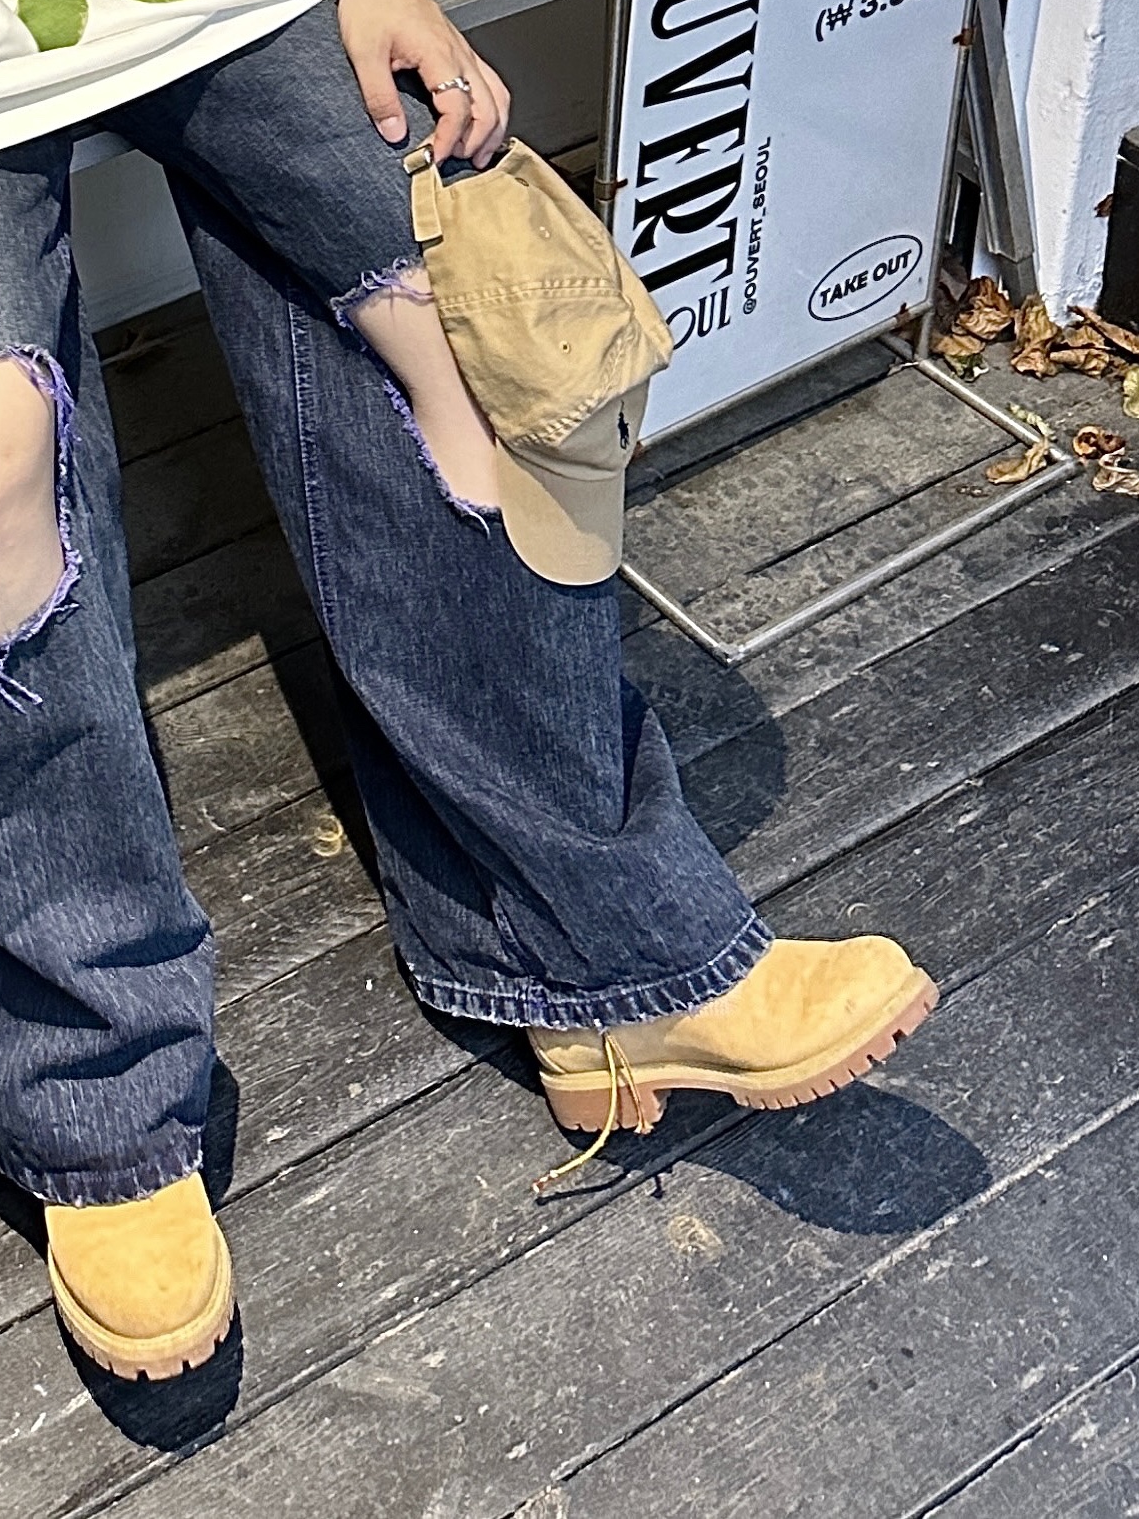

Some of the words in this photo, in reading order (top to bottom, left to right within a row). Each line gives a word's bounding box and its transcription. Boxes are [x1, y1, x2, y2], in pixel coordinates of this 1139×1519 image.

[743, 136, 771, 315] @OUVERT_SEOUL
[820, 270, 869, 308] TAKE
[872, 249, 913, 282] OUT
[665, 286, 731, 351] OUL
